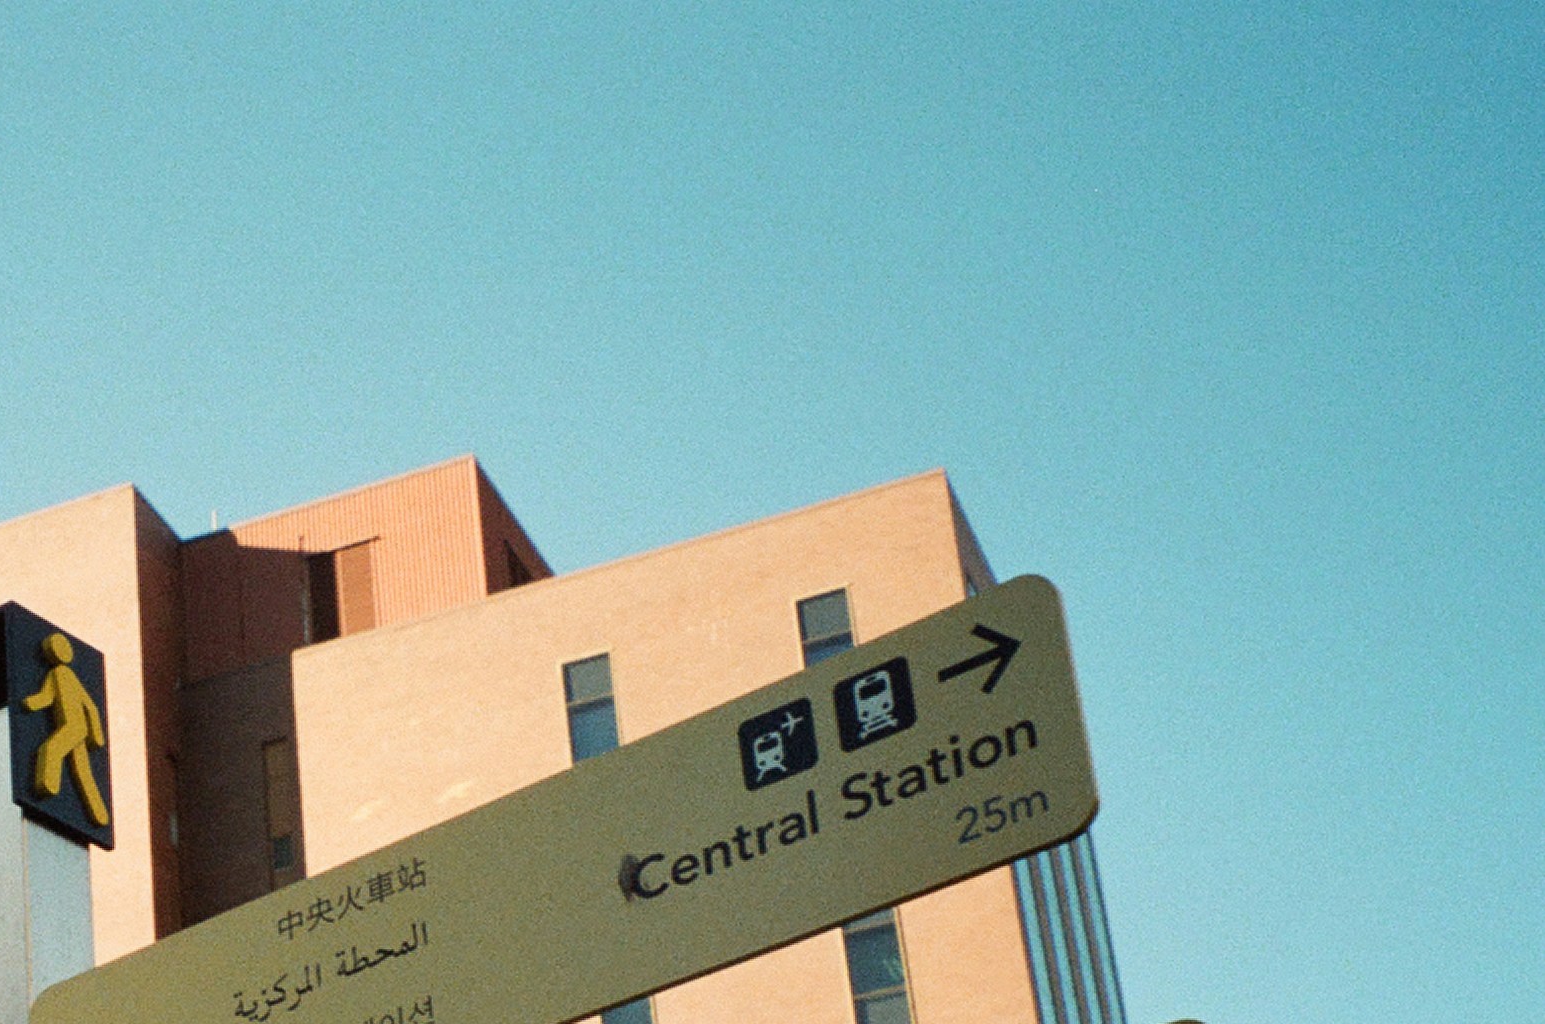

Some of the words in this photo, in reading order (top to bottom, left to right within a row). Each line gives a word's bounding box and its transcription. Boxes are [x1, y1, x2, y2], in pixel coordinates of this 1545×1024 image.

[634, 790, 819, 899] Central
[841, 719, 1037, 821] Station
[955, 790, 1049, 844] 25m
[277, 857, 427, 940] 中央火車站
[335, 921, 429, 977] المحطة
[233, 963, 322, 1022] المركزية
